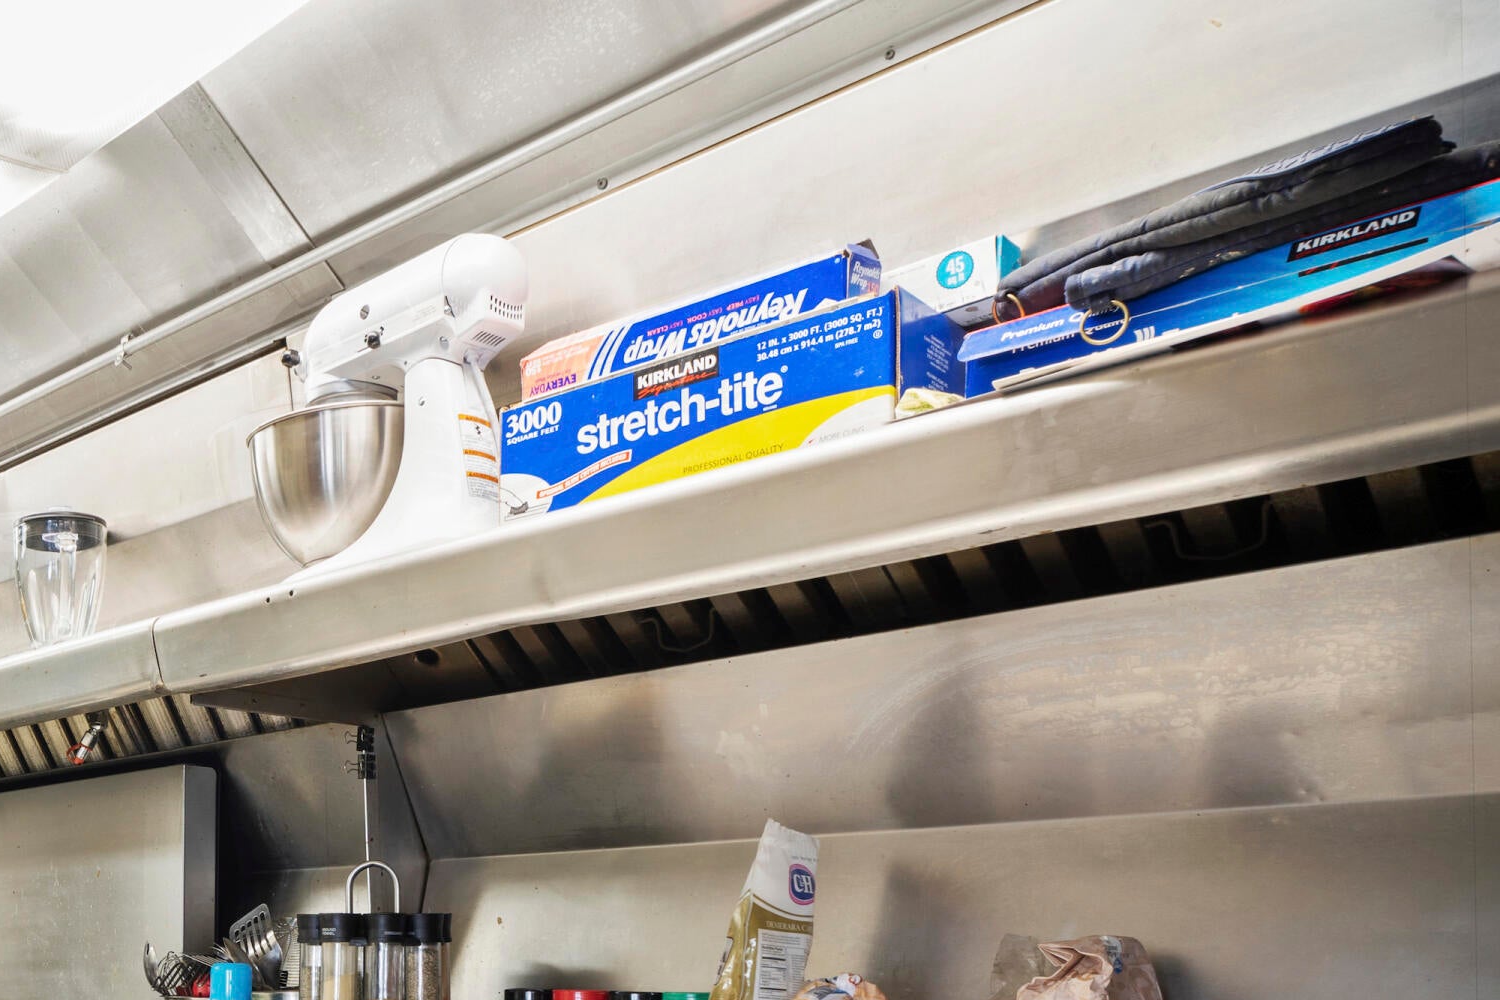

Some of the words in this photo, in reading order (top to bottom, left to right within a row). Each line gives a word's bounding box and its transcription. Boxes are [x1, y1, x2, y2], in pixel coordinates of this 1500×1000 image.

[1296, 210, 1417, 253] KIRKLAND
[850, 272, 867, 288] Wrap
[852, 260, 881, 280] Reynolds
[945, 255, 965, 272] 45
[686, 311, 708, 324] COOK
[687, 288, 809, 346] Reynolds
[756, 341, 765, 352] 12
[767, 338, 779, 350] IN.
[788, 329, 808, 344] 3000
[809, 325, 823, 338] FT.
[824, 316, 849, 334] (3000
[849, 312, 865, 326] SQ.
[866, 306, 883, 321] FT.)
[1000, 318, 1065, 342] Premium
[623, 329, 689, 364] Wrap
[756, 349, 779, 363] 30.48
[779, 346, 792, 356] cm
[800, 334, 824, 350] 914.4
[825, 332, 834, 342] m
[834, 323, 862, 343] (278.7
[863, 318, 882, 332] m2)
[529, 373, 577, 397] EVERYDAY
[636, 354, 718, 390] KIRKLAND
[637, 371, 718, 399] Signature
[505, 401, 562, 439] 3000
[576, 369, 785, 455] stretch-tite
[506, 431, 539, 446] SQUARE
[539, 424, 560, 439] FEET
[683, 451, 744, 475] PROFESSIONAL
[745, 442, 784, 461] QUALITY
